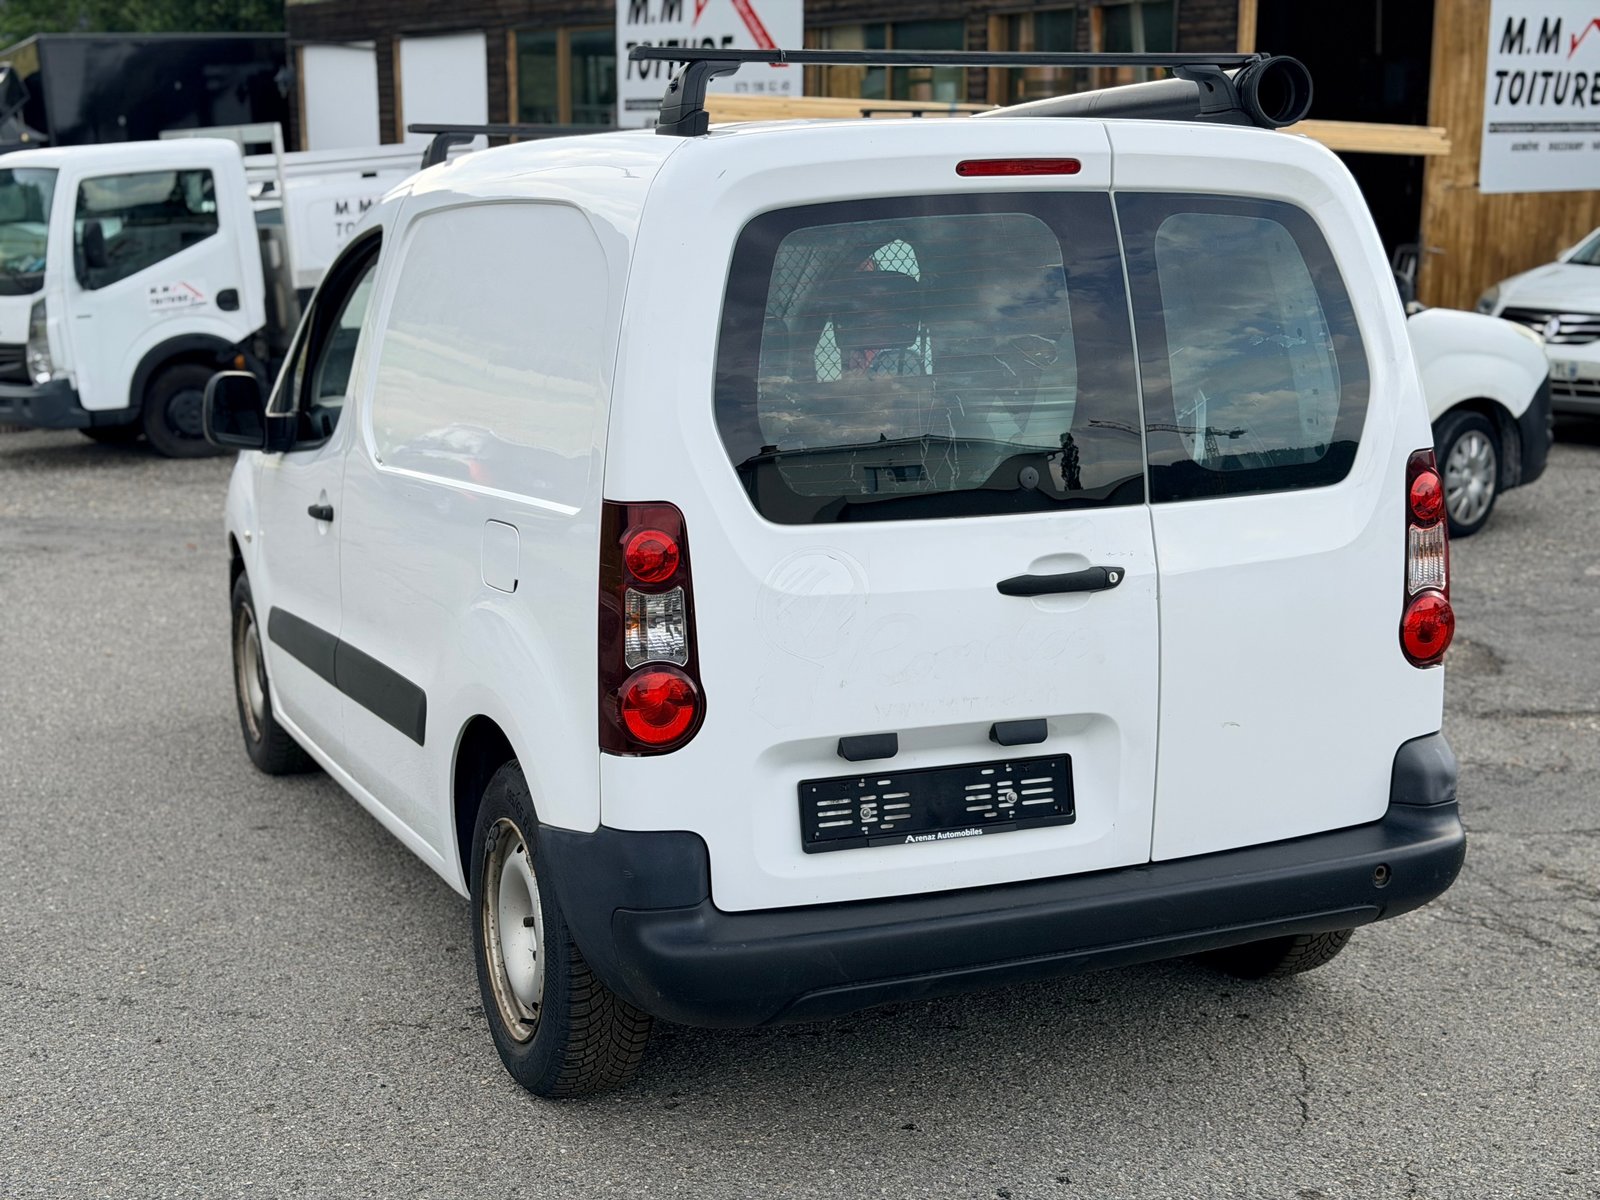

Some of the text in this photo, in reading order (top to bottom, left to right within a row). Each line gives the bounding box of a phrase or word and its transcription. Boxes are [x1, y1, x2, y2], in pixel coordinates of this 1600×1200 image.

[1499, 16, 1562, 54] M.M
[905, 828, 983, 844] Arenaz Automobiles
